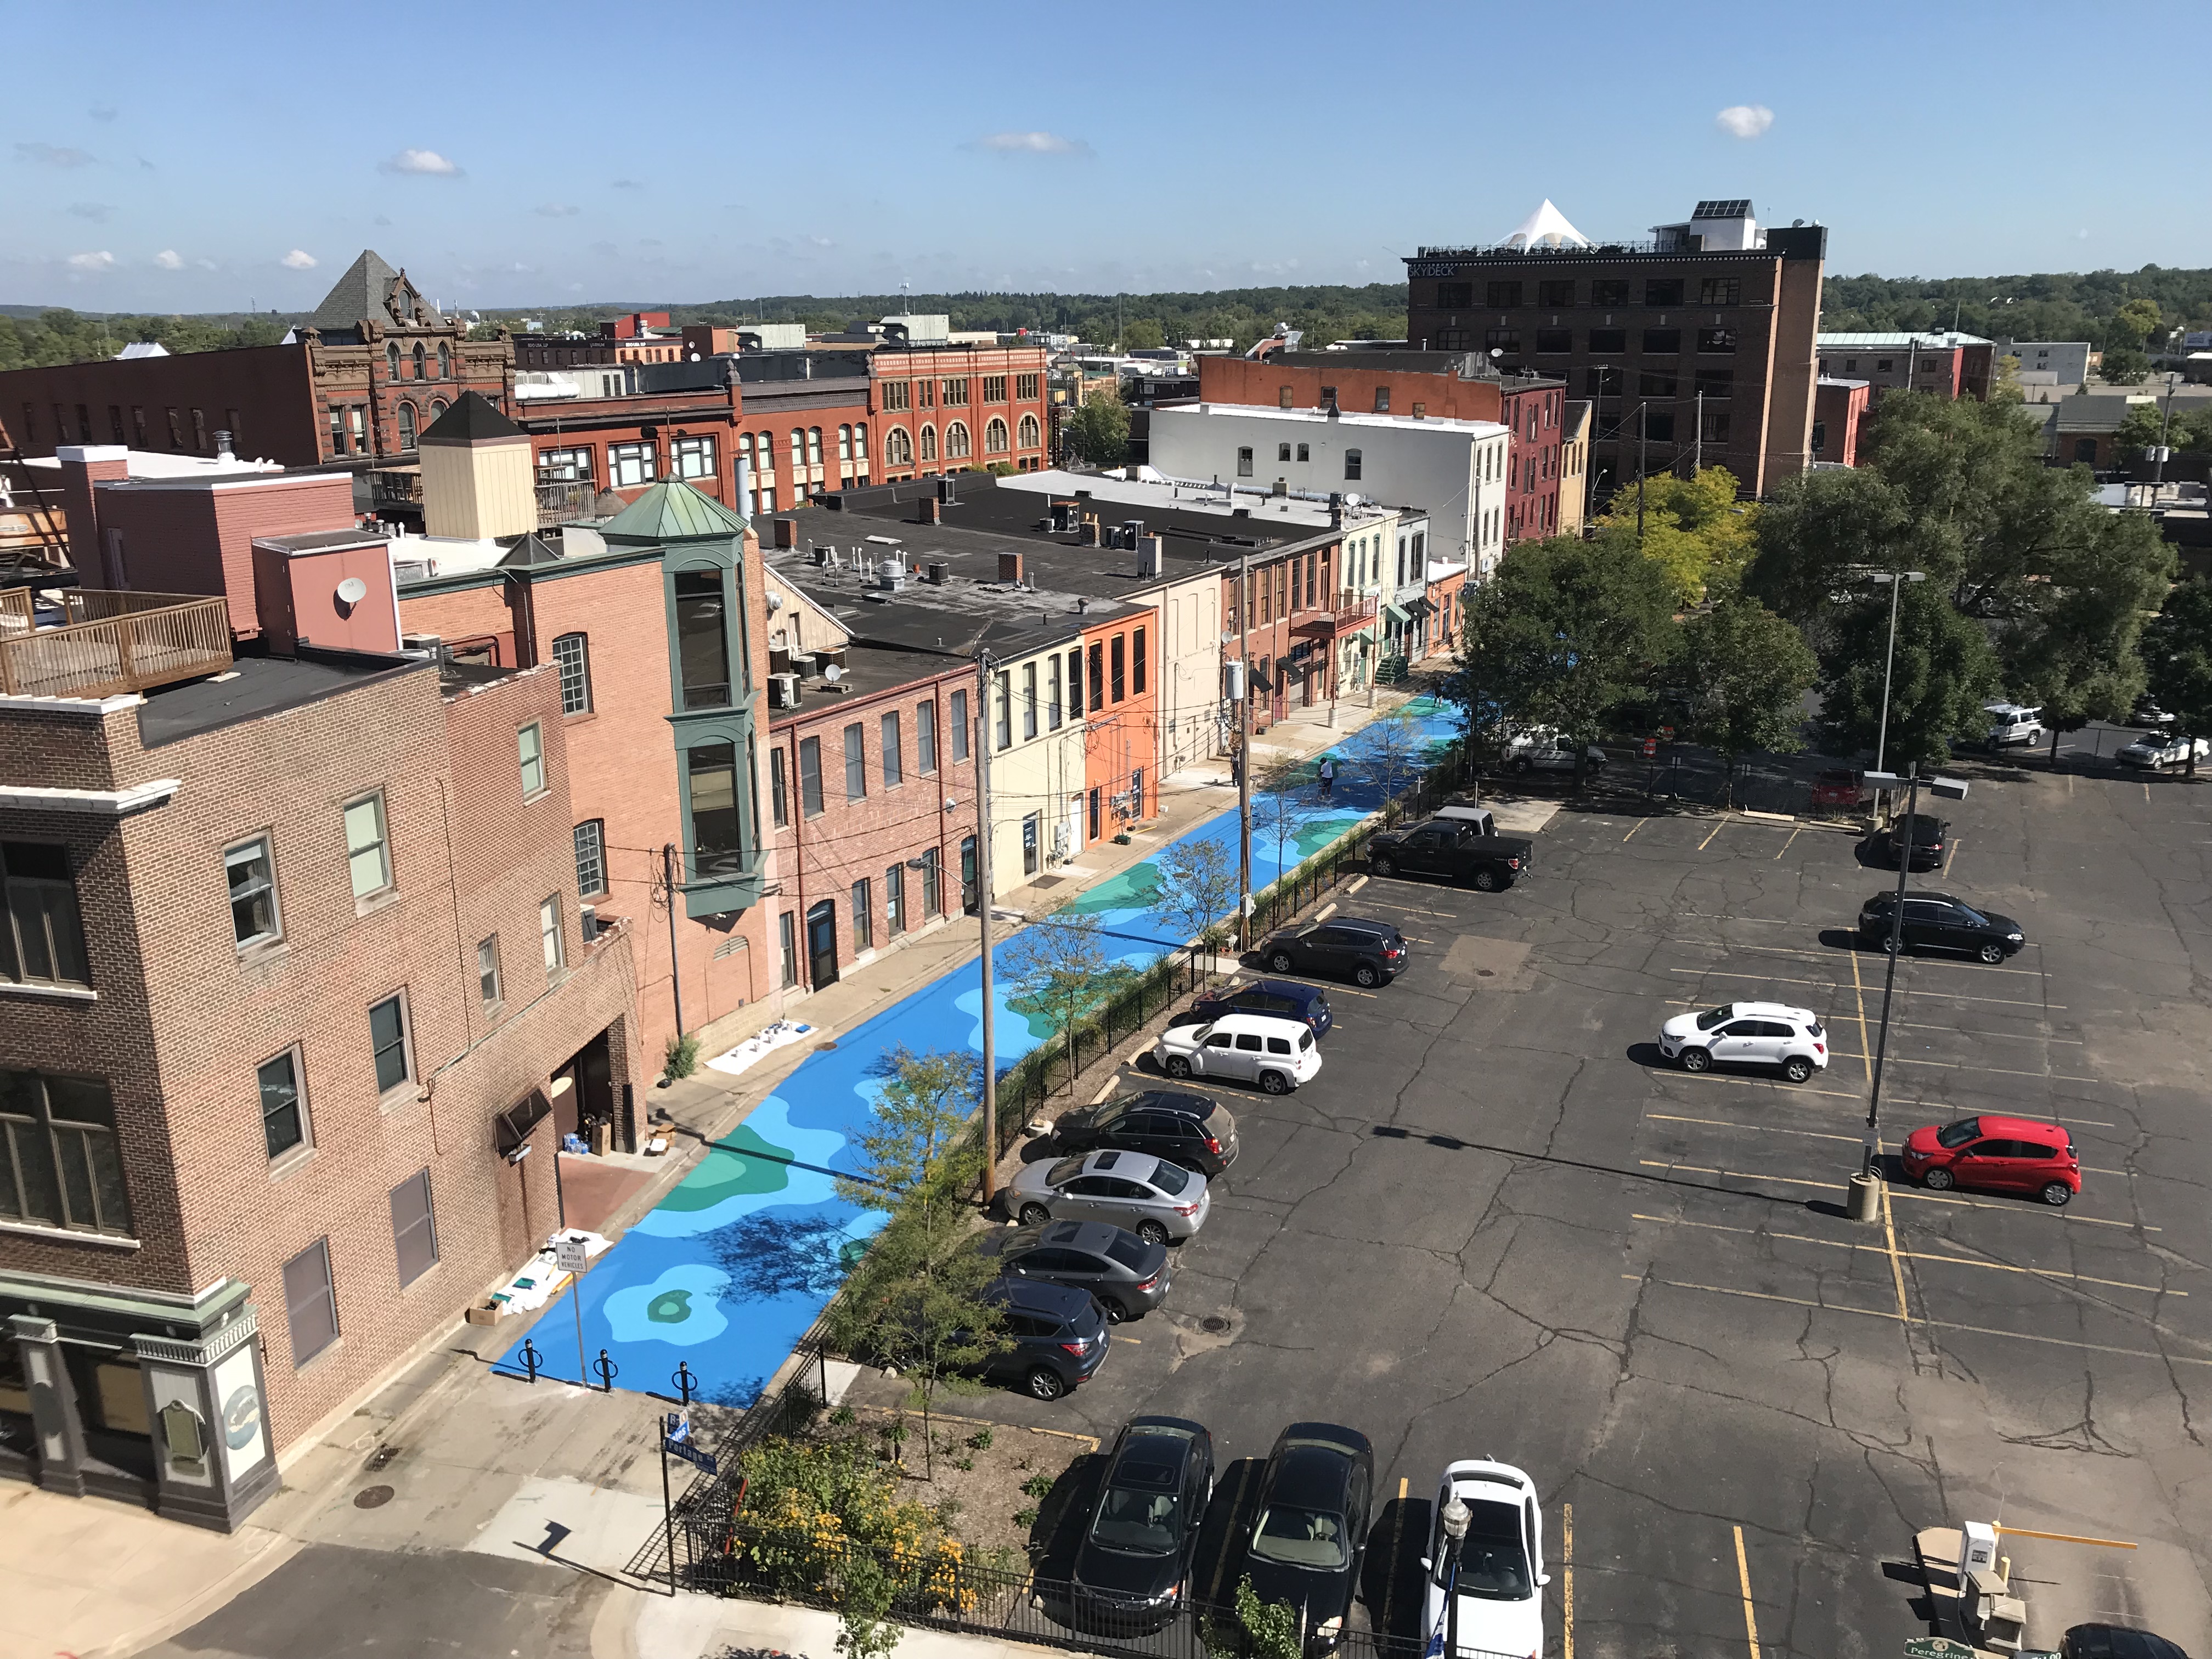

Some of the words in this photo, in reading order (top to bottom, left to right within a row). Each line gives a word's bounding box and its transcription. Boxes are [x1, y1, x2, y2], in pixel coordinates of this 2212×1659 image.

[1409, 266, 1455, 276] SKYDECK
[669, 1439, 703, 1462] Portage
[1911, 1647, 1968, 1659] Peregrine
